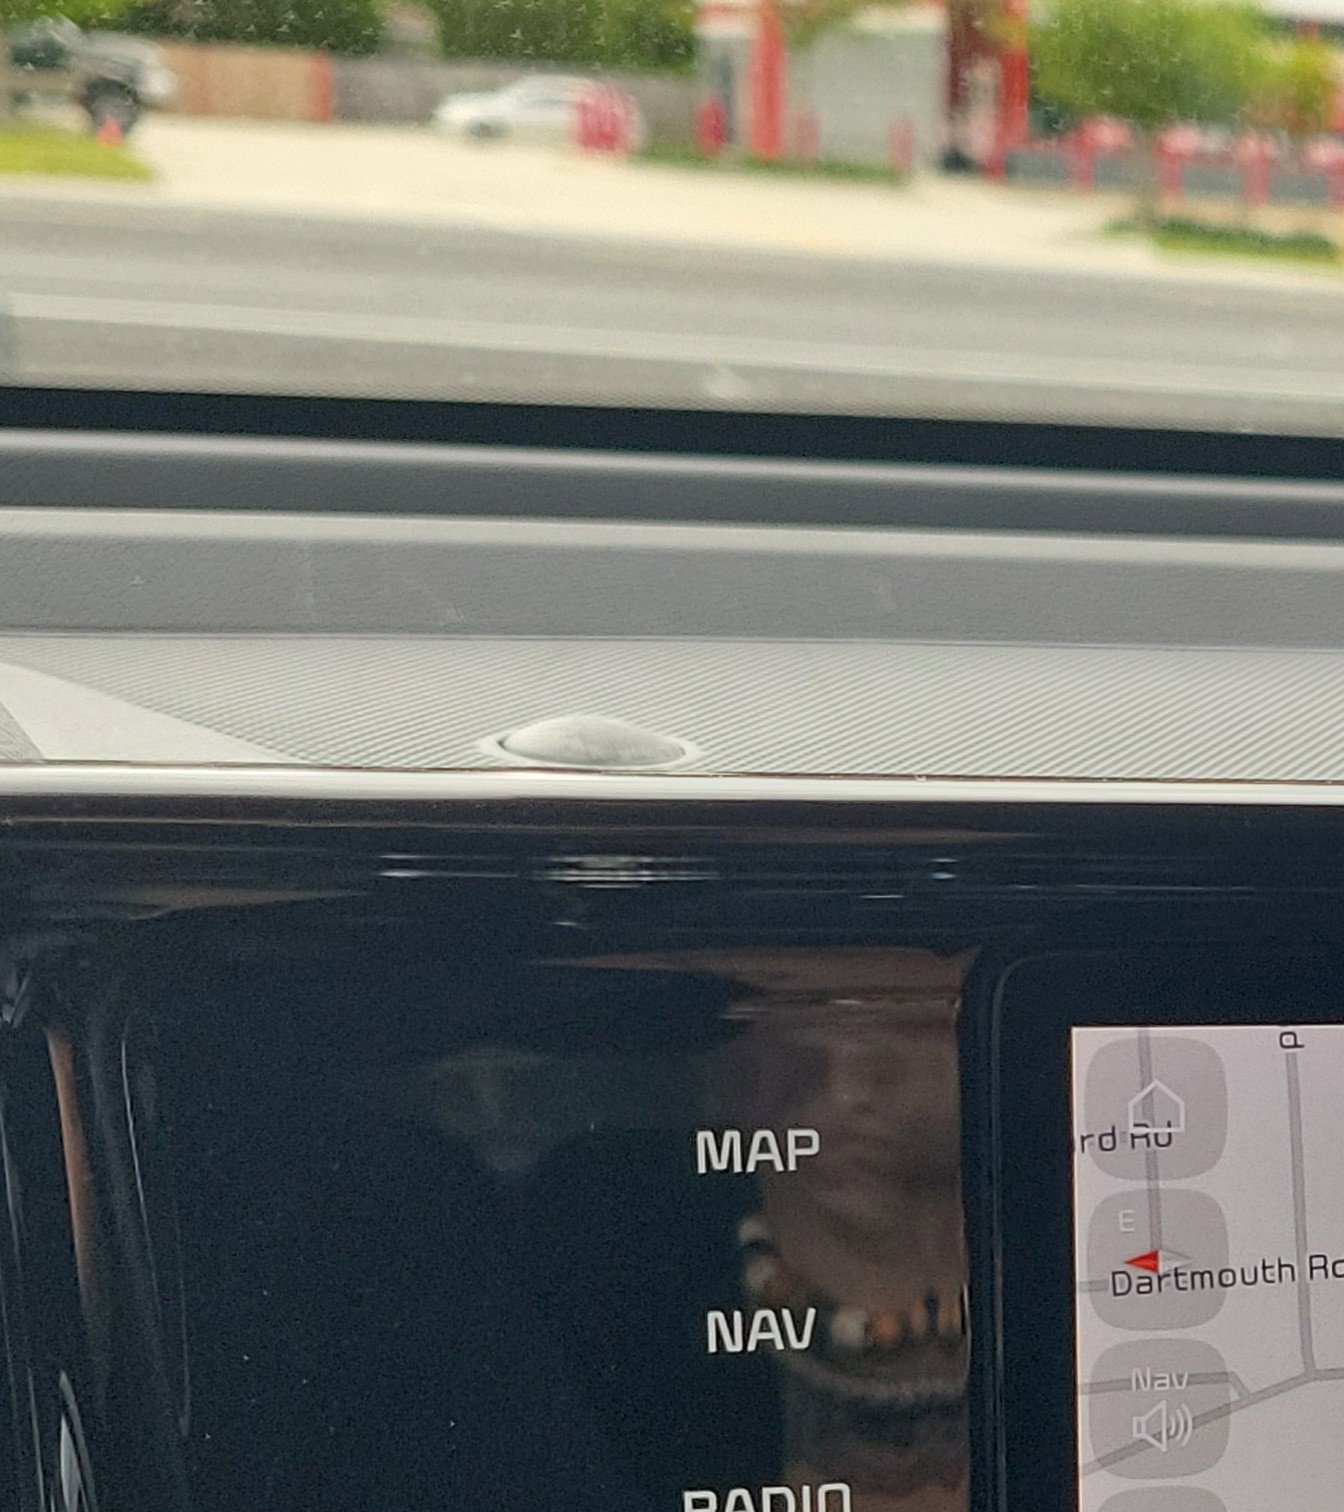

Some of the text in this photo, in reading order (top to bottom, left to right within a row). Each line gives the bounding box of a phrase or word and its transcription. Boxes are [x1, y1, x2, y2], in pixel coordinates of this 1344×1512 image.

[696, 1128, 820, 1174] MAP
[1129, 1120, 1173, 1150] Rd
[1118, 1209, 1136, 1232] E
[1111, 1257, 1296, 1298] Dartmouth
[706, 1307, 817, 1354] NAV
[1129, 1365, 1190, 1392] Nav
